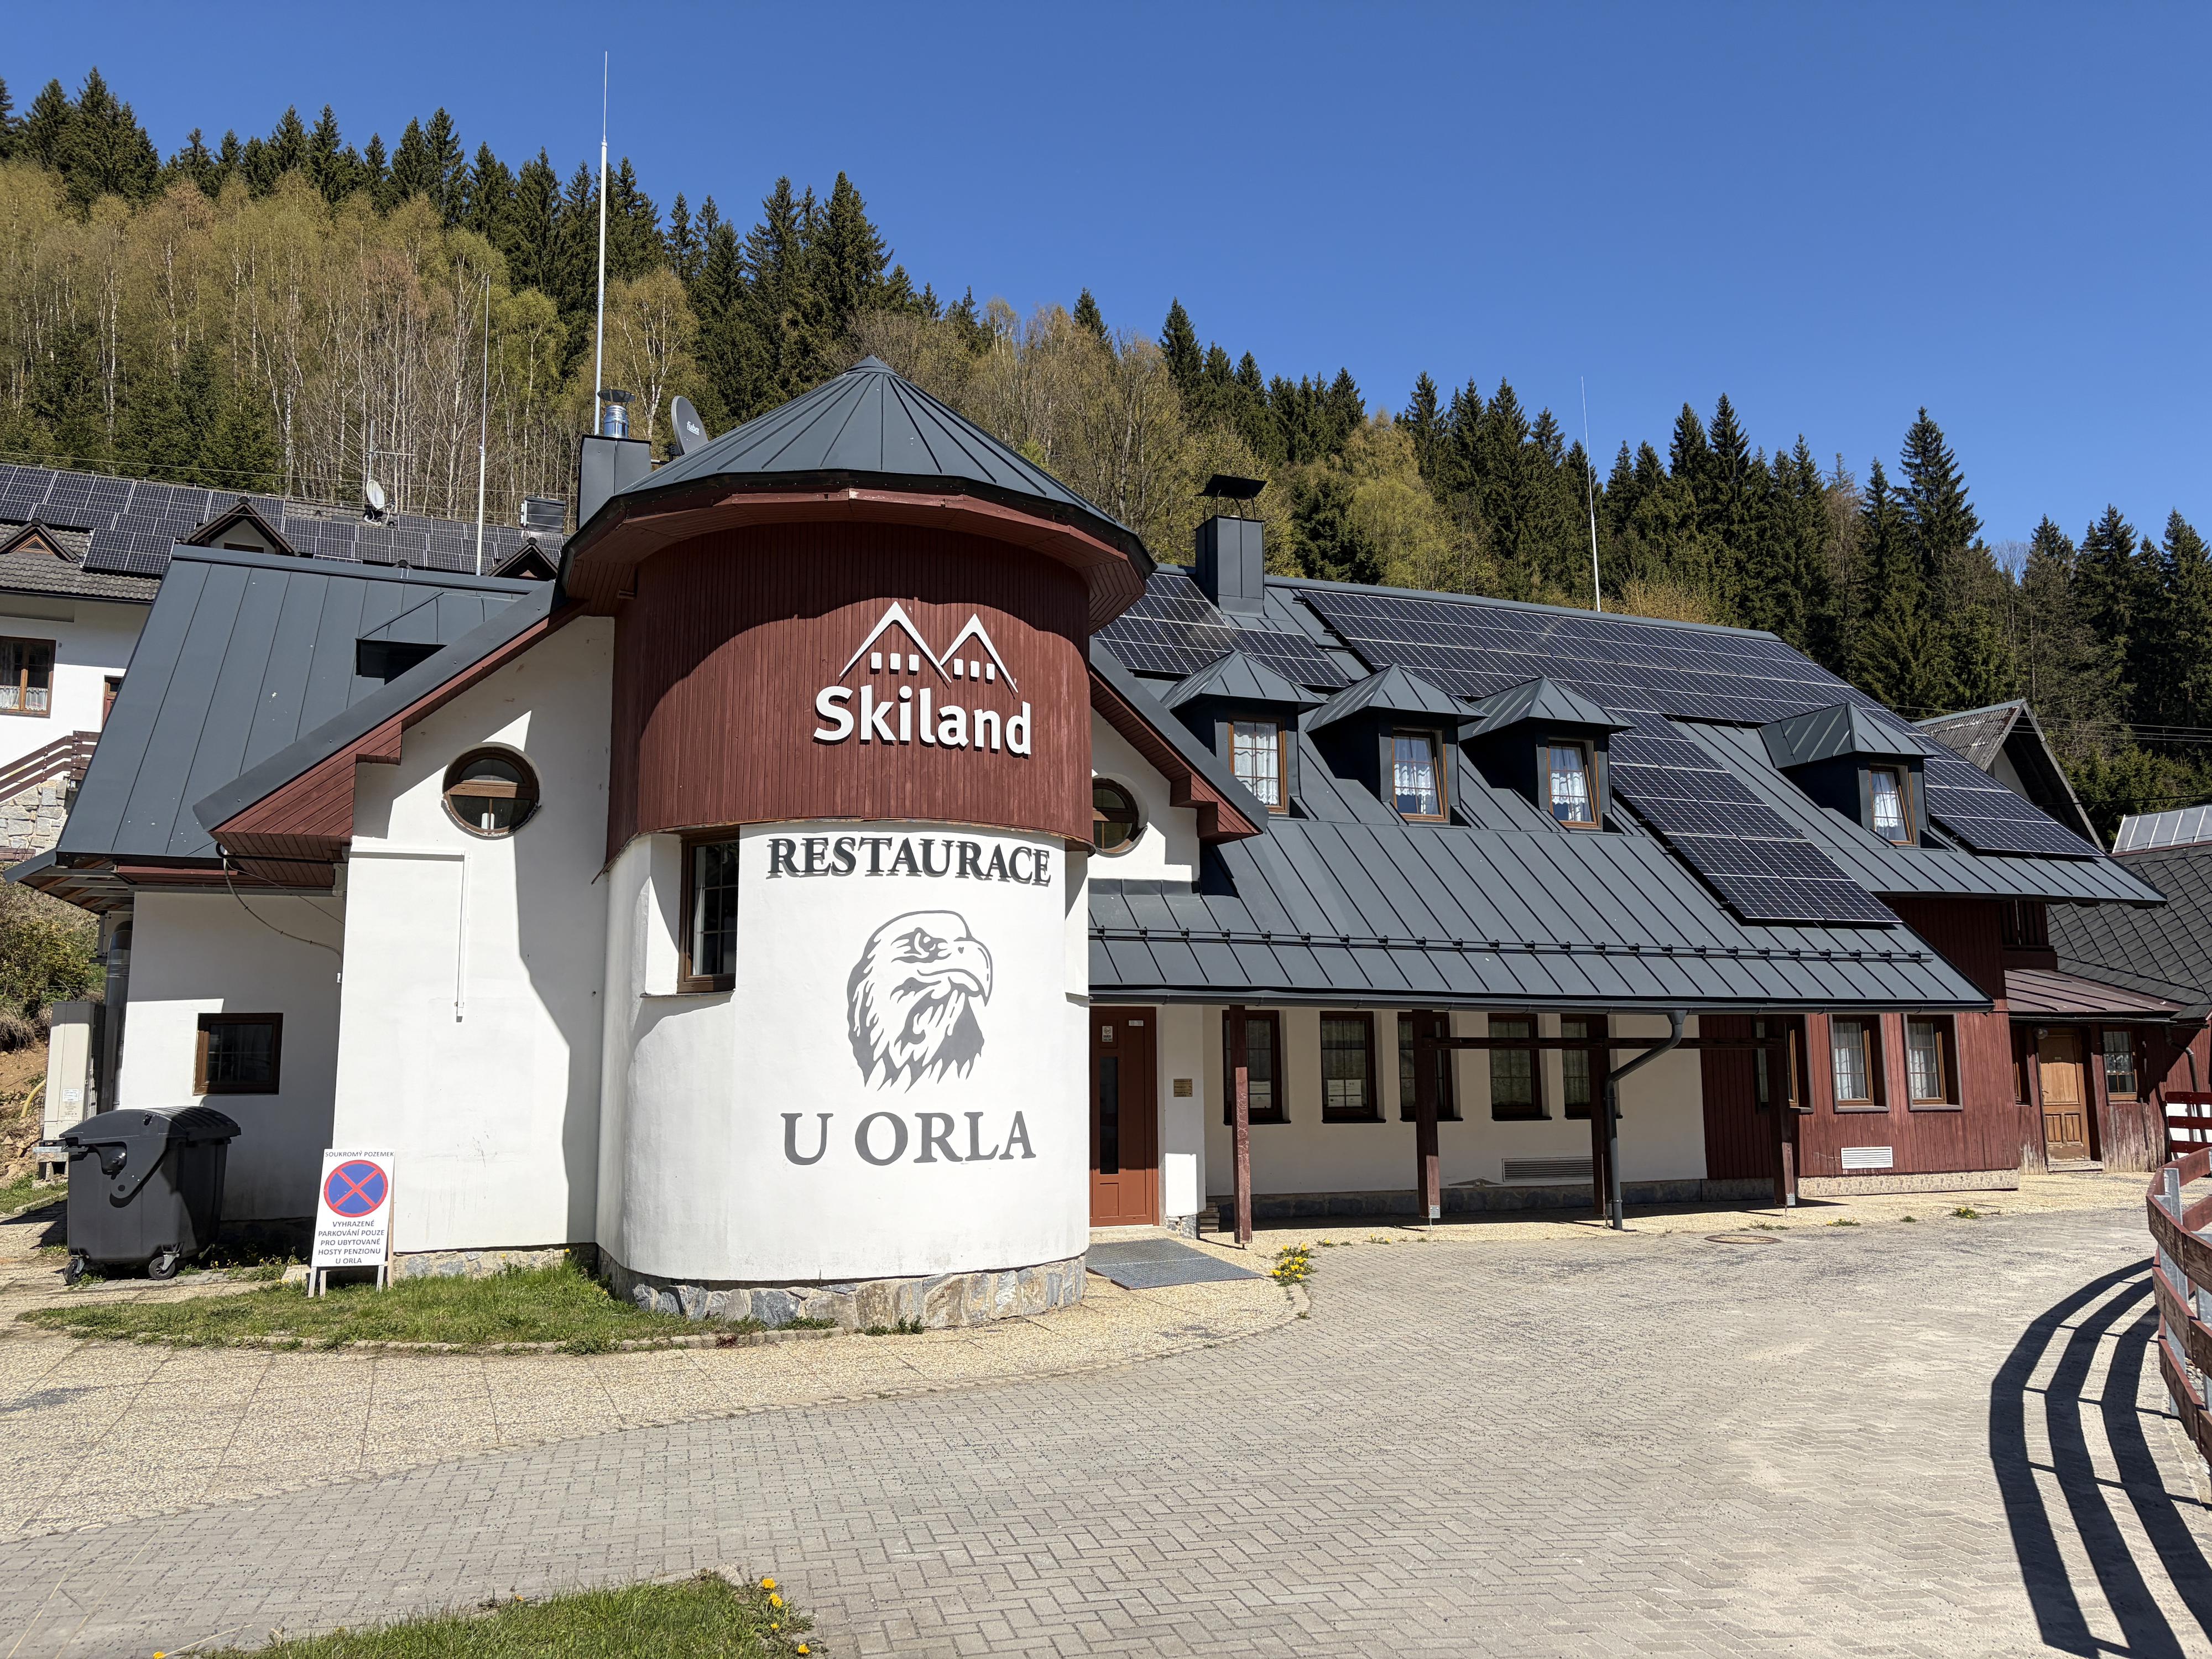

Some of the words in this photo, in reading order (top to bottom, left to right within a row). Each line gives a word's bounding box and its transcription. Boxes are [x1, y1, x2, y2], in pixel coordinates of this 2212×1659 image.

[686, 420, 700, 435] fuba
[813, 685, 1031, 755] Skiland
[767, 836, 1051, 886] RESTAURACE
[780, 1112, 834, 1165] U
[854, 1110, 1036, 1166] ORLA
